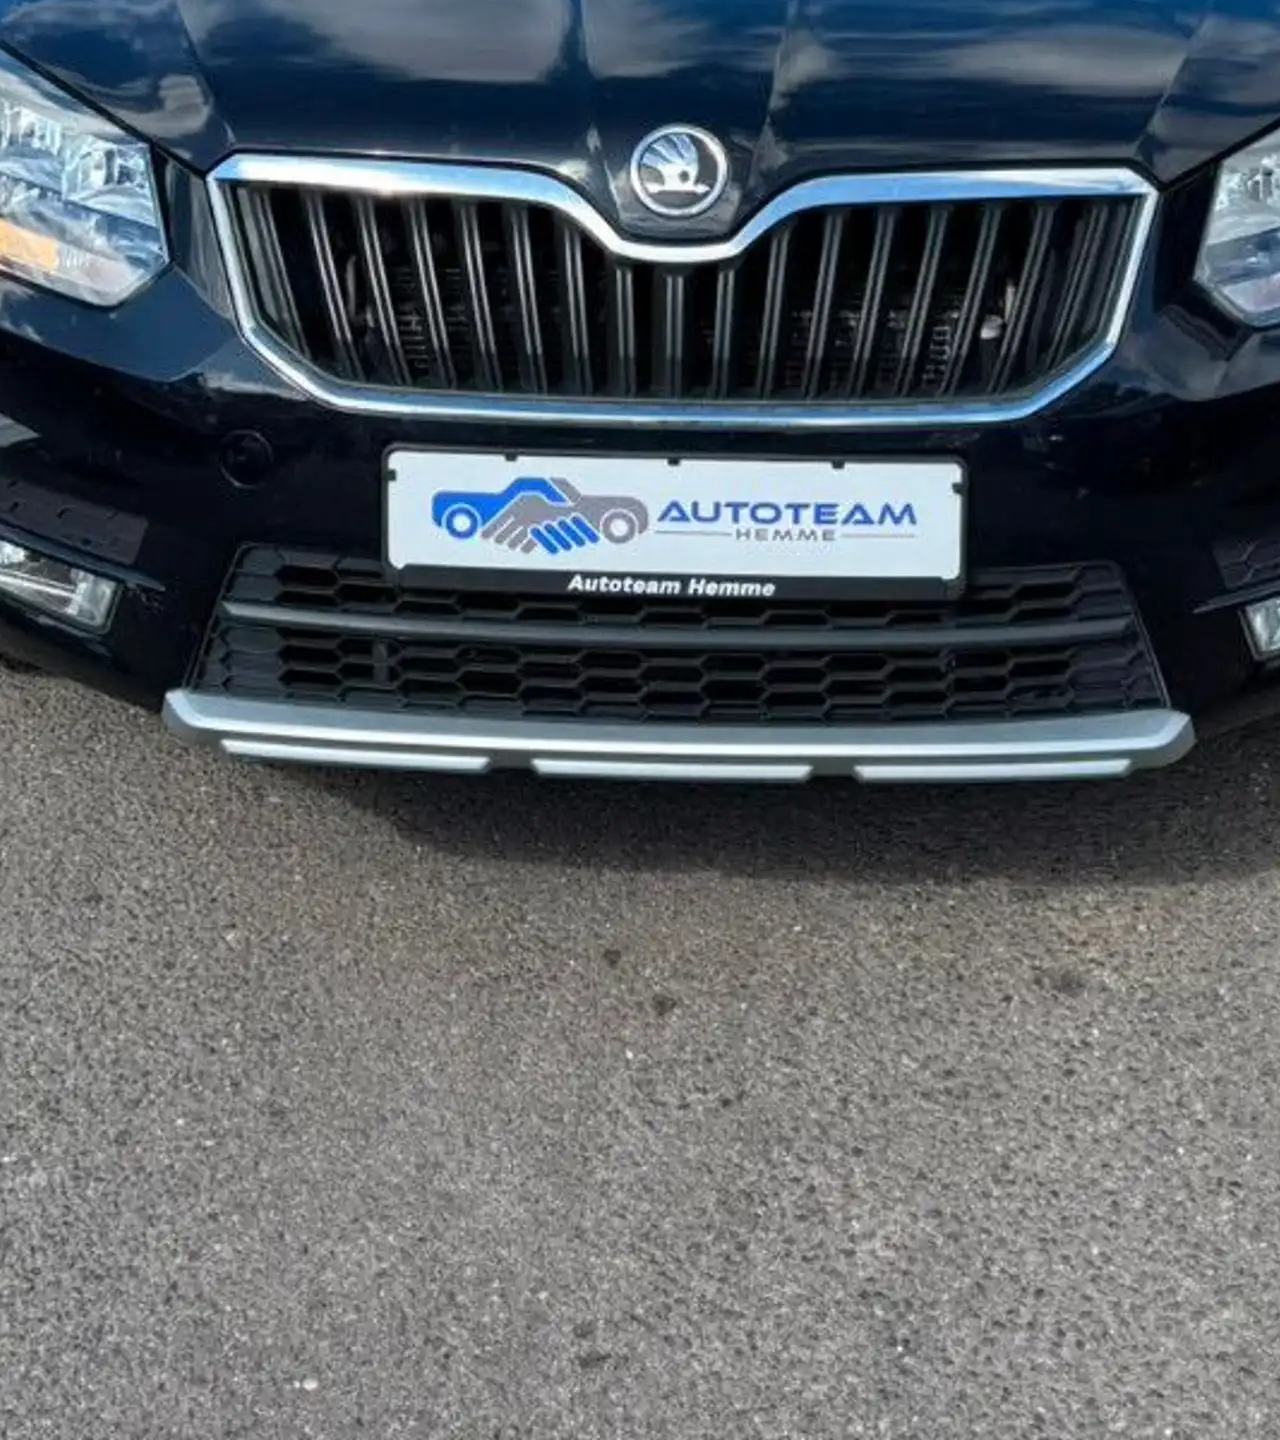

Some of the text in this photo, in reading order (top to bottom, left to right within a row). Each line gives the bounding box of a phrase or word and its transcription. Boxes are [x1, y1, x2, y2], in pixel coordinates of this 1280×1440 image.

[656, 499, 918, 527] AUTOTEAM
[735, 528, 837, 543] HEMME
[567, 574, 777, 598] Autoteam Hemme
